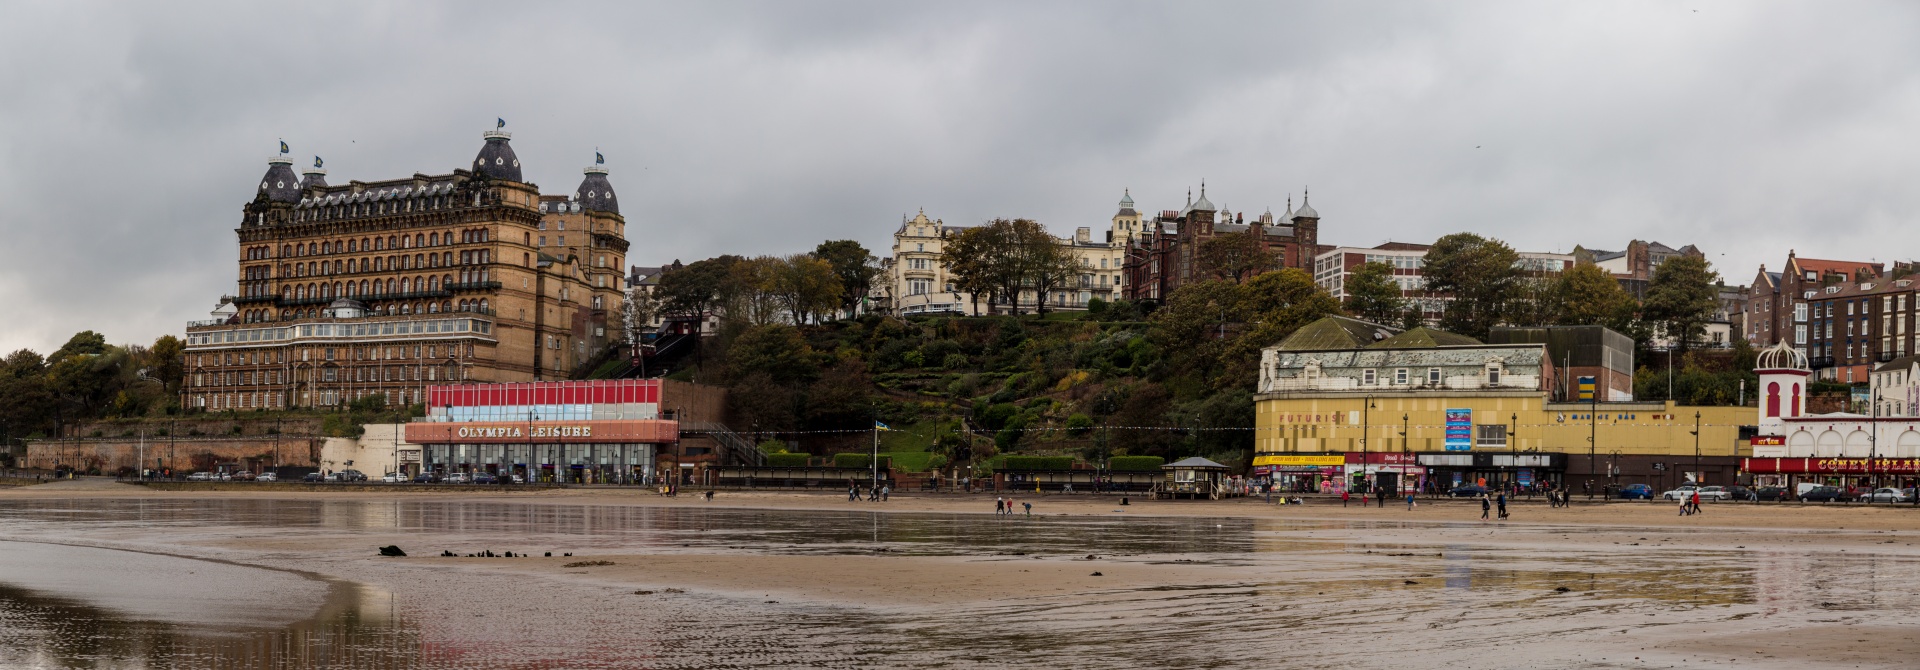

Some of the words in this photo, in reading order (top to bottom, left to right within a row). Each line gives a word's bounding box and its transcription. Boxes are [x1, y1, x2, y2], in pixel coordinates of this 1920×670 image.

[458, 426, 522, 438] OLYMPIA
[528, 426, 591, 437] LEISURE
[1818, 459, 1868, 470] CONEY
